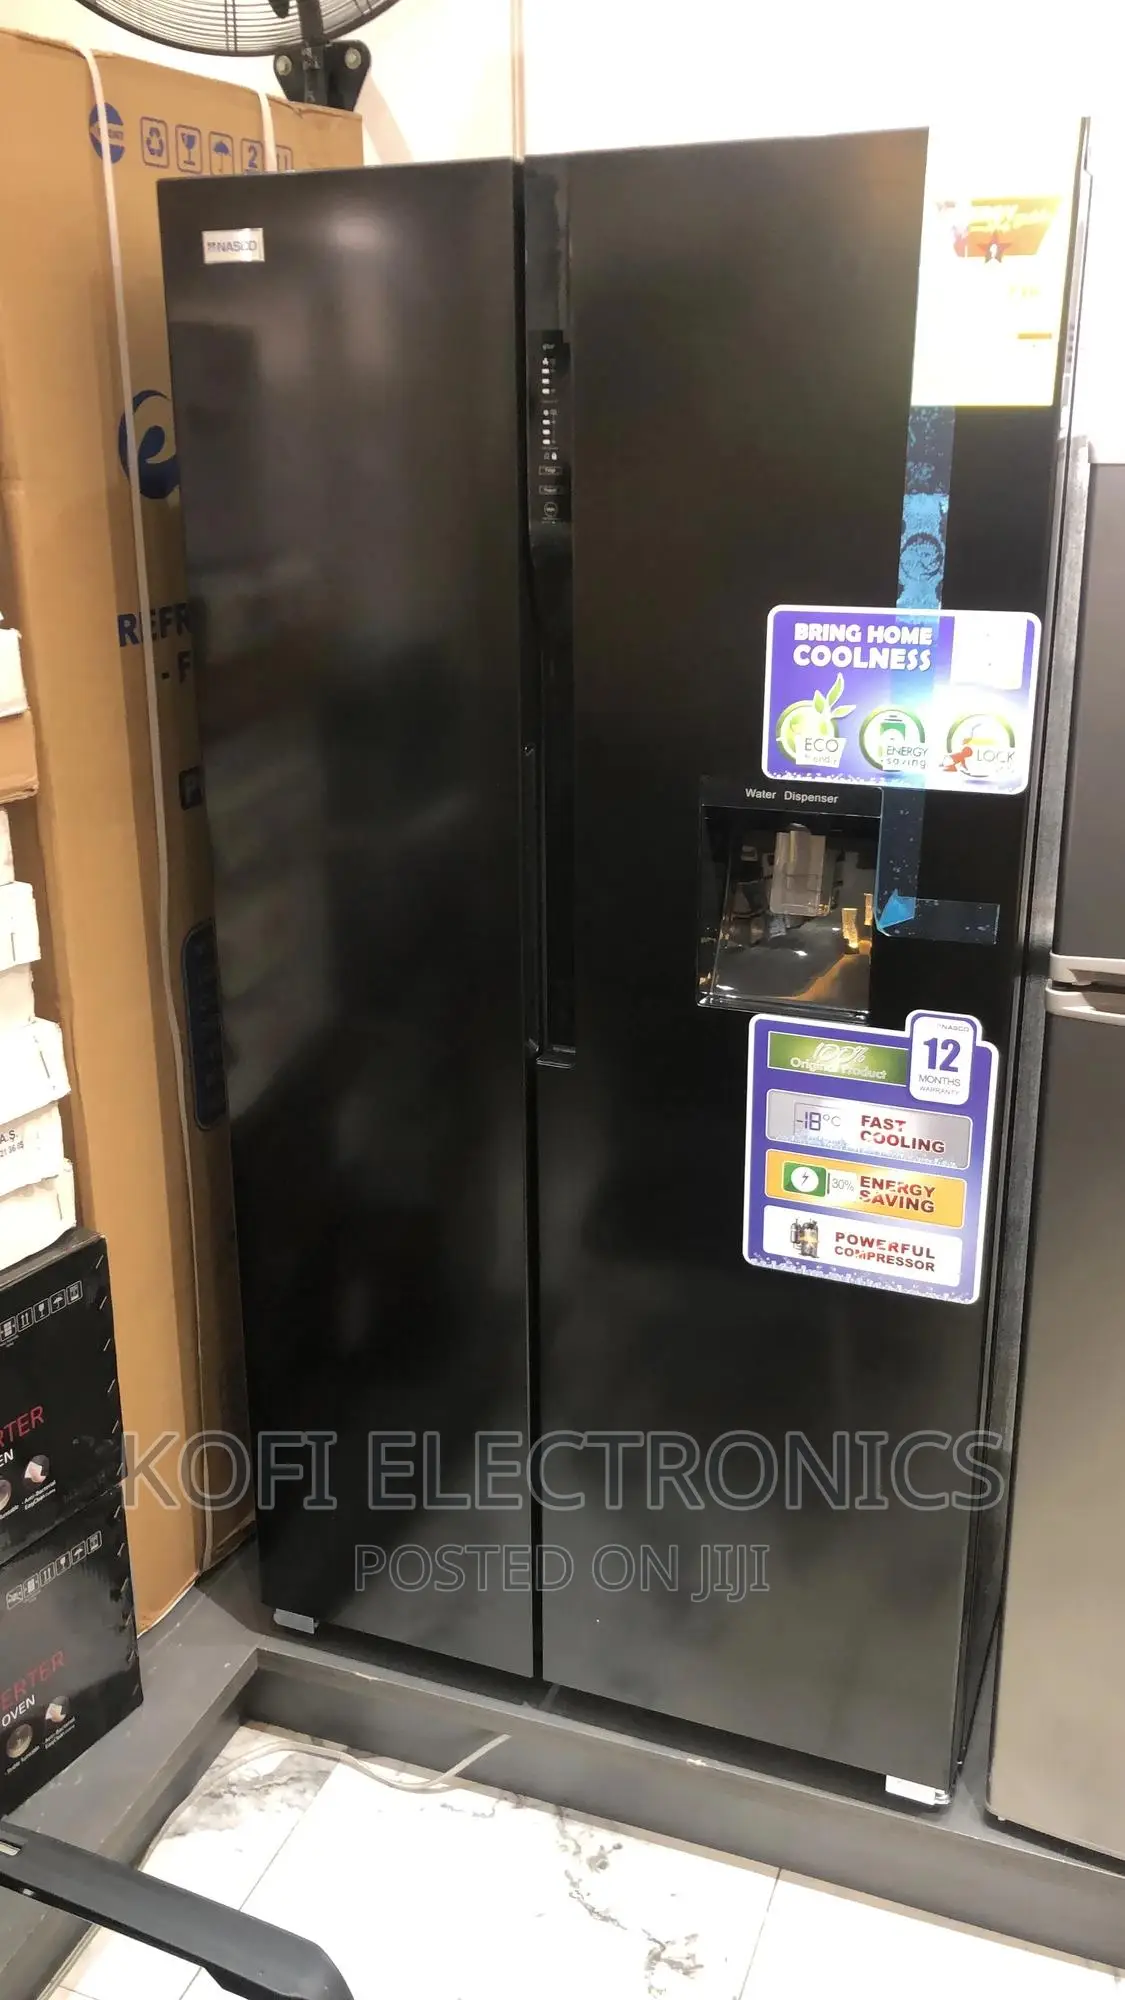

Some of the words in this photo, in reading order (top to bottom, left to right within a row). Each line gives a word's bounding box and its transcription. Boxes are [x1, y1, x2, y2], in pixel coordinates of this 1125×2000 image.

[216, 239, 258, 252] NASCO
[794, 622, 862, 643] BRING
[867, 625, 933, 646] HOME
[793, 644, 932, 672] COOLNESS
[804, 737, 839, 753] ECO
[886, 745, 928, 757] ENERGY
[976, 748, 1016, 763] LOCK
[745, 788, 777, 800] Water
[784, 790, 838, 804] Dispenser
[923, 1037, 961, 1073] 12
[789, 1056, 839, 1073] Original
[842, 1063, 888, 1080] Product
[918, 1074, 961, 1087] MONTHS
[919, 1086, 960, 1096] WARRANTY
[860, 1115, 907, 1132] FAST
[860, 1130, 945, 1153] COOLING
[831, 1177, 855, 1193] 30%
[860, 1175, 936, 1198] ENERGY
[859, 1190, 935, 1214] SAVING
[835, 1231, 936, 1259] POWERFUL
[834, 1246, 936, 1272] COMPRESSOR
[2, 1694, 36, 1727] OVEN
